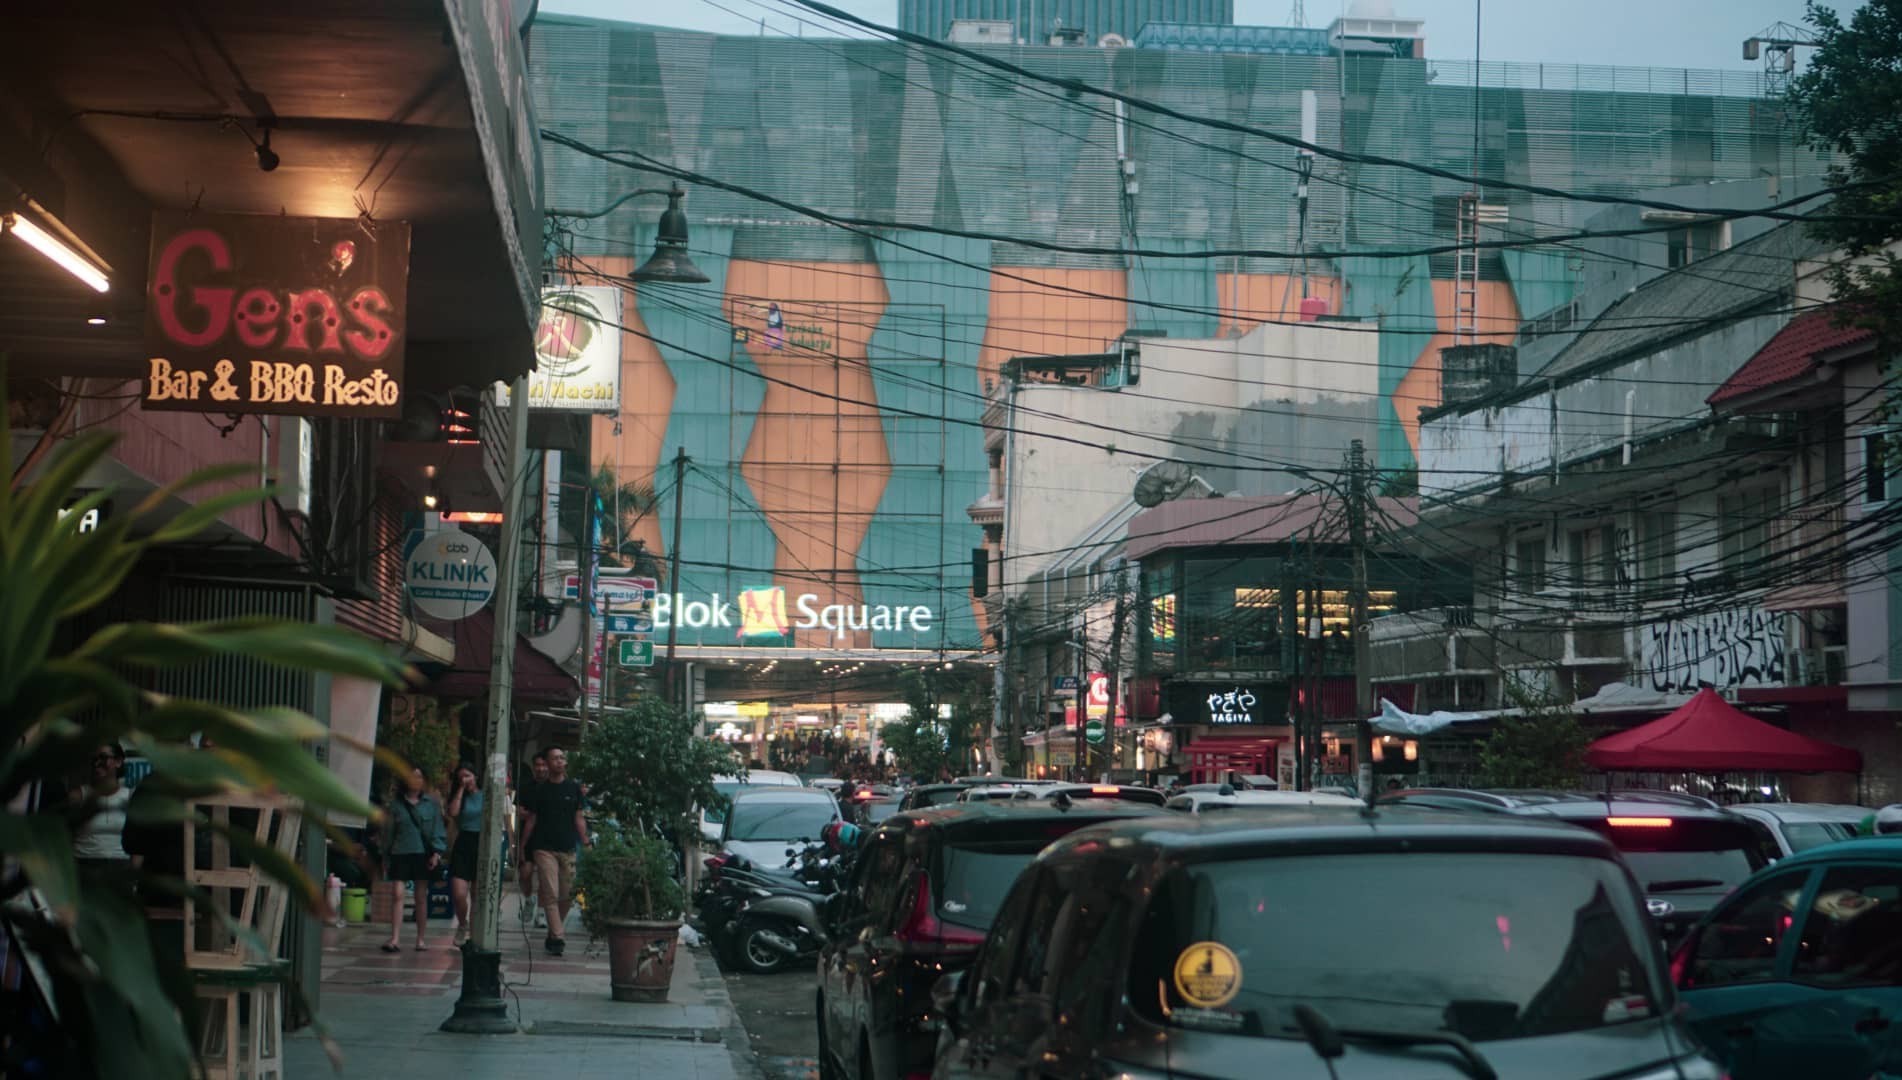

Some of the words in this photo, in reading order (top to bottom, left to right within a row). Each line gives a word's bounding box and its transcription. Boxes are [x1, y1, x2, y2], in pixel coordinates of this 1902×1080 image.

[154, 229, 397, 357] Gen's
[149, 359, 207, 402] Bar
[211, 359, 239, 401] &
[250, 361, 315, 405] BBQ
[323, 366, 400, 407] Resto
[412, 560, 489, 584] KLINIK
[653, 592, 731, 630] Blok
[796, 593, 933, 640] Square
[1206, 686, 1257, 713] やぎや
[1211, 712, 1252, 723] YAGIYA
